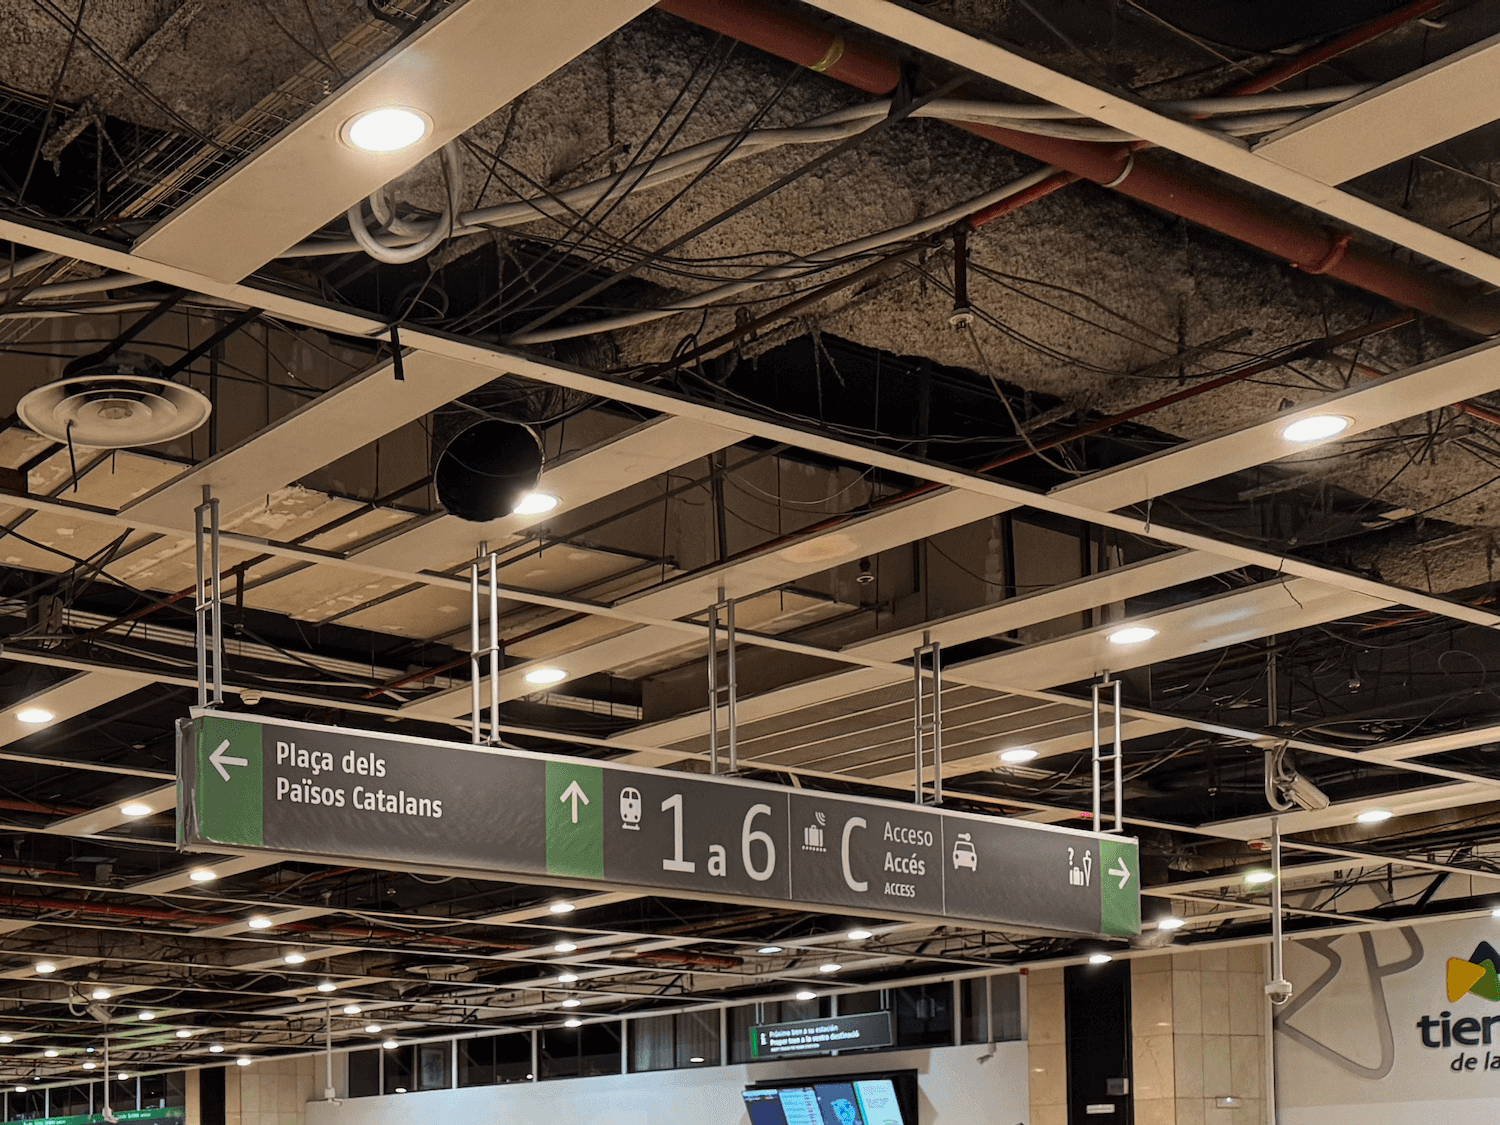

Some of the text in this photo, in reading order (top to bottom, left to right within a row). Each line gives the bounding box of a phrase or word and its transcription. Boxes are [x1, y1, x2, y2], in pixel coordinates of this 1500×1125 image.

[276, 741, 387, 777] Plaça dels
[276, 776, 443, 818] Països Catalans
[661, 793, 776, 881] 1 a 6
[883, 821, 933, 847] Acceso
[841, 816, 868, 893] C
[883, 851, 926, 876] Accés
[884, 882, 916, 898] ACCESS
[1450, 1052, 1478, 1071] de
